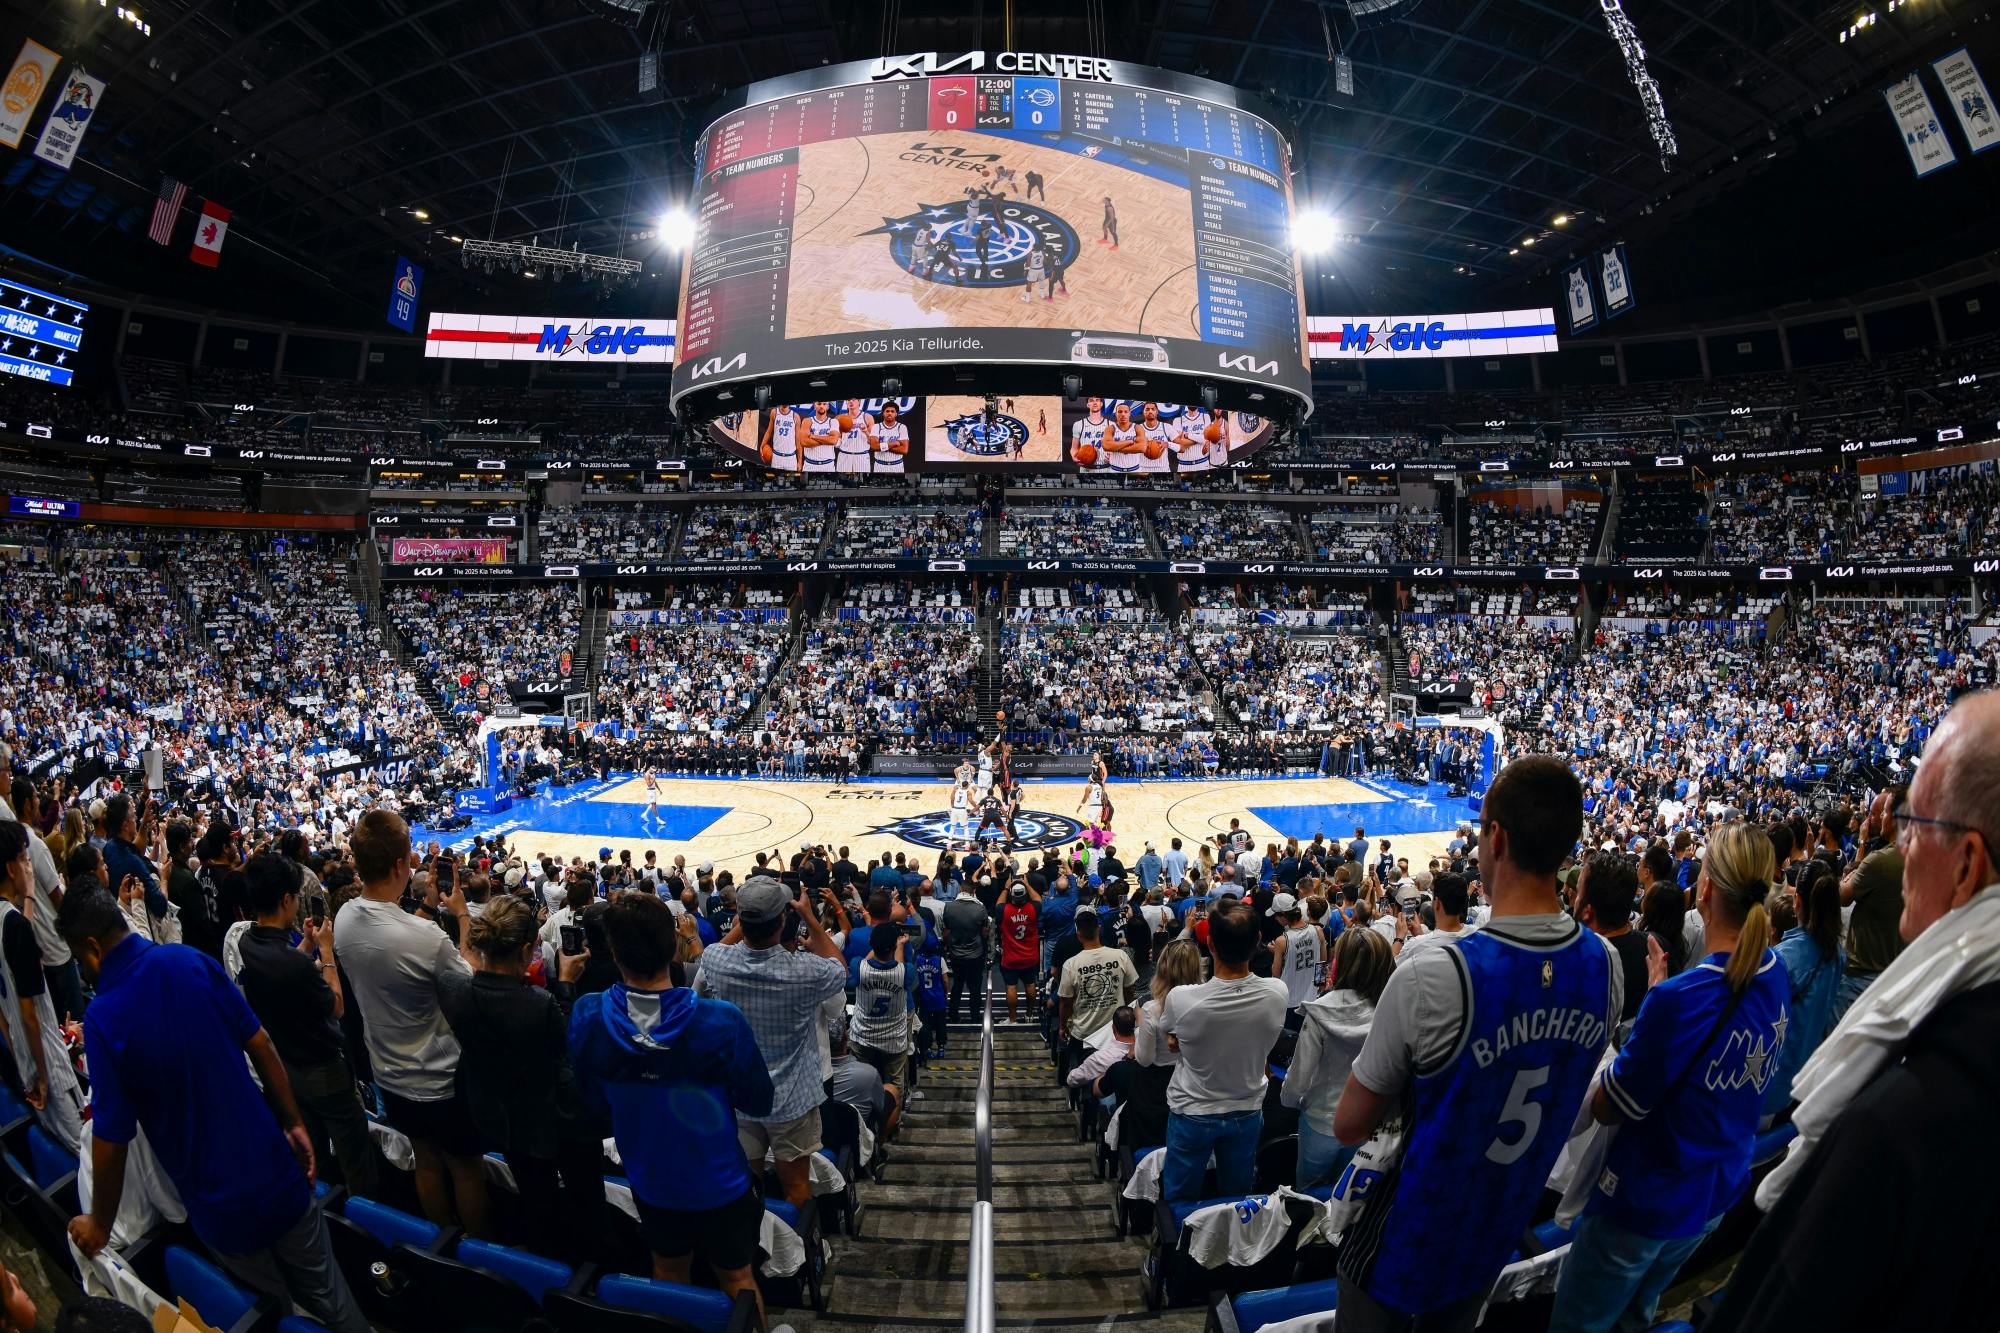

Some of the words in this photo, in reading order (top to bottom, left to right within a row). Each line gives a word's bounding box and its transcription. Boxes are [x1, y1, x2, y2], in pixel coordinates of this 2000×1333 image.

[995, 52, 1113, 83] CENTER
[1944, 61, 1965, 75] EASTERN
[1945, 67, 1975, 85] CONFERENCE
[979, 80, 1011, 89] 12:00
[1894, 86, 1915, 101] EASTERN
[1085, 100, 1114, 109] BANCHERO
[1894, 92, 1924, 111] CONFERENCE
[946, 111, 957, 124] 0
[979, 116, 1010, 124] KIA
[1032, 111, 1042, 124] 0
[1086, 116, 1109, 124] WAGNER
[910, 143, 1001, 162] KIA
[726, 163, 745, 176] TEAM
[746, 153, 784, 168] NUMBERS
[899, 152, 988, 173] CENTER
[1228, 161, 1249, 175] TEAM
[1250, 167, 1279, 189] NUMBERS
[1208, 275, 1222, 284] TEAM
[1607, 269, 1622, 292] 32
[1209, 285, 1237, 296] TURNOVERS
[1209, 295, 1228, 305] POINTS
[1575, 288, 1583, 308] 6
[397, 300, 410, 321] 49
[1210, 305, 1223, 314] FAST
[1211, 316, 1228, 325] BENCH
[53, 329, 72, 343] MAKE
[1211, 326, 1232, 337] BIGGEST
[825, 344, 850, 356] The
[854, 340, 888, 354] 2025
[892, 338, 914, 351] Kia
[918, 337, 984, 350] Telluride.
[691, 352, 747, 380] KIA
[1219, 352, 1278, 376] KIA
[779, 428, 789, 437] 93
[1841, 442, 1863, 452] KIA
[1713, 453, 1735, 461] KIA
[46, 502, 65, 510] ULTRA
[617, 566, 647, 574] KIA
[787, 563, 817, 571] KIA
[1028, 561, 1059, 569] KIA
[1827, 567, 1853, 576] KIA
[1866, 567, 1876, 575] only
[1923, 565, 1935, 574] good
[1634, 569, 1662, 577] KIA
[1421, 683, 1456, 693] KIA
[1011, 915, 1028, 923] WADE
[1014, 925, 1026, 939] 3
[1295, 949, 1315, 972] 22
[1078, 961, 1119, 975] 1989-90
[924, 972, 933, 989] 5
[869, 997, 891, 1018] 5
[1471, 1007, 1604, 1069] BANCHERO
[1484, 1064, 1551, 1165] 5
